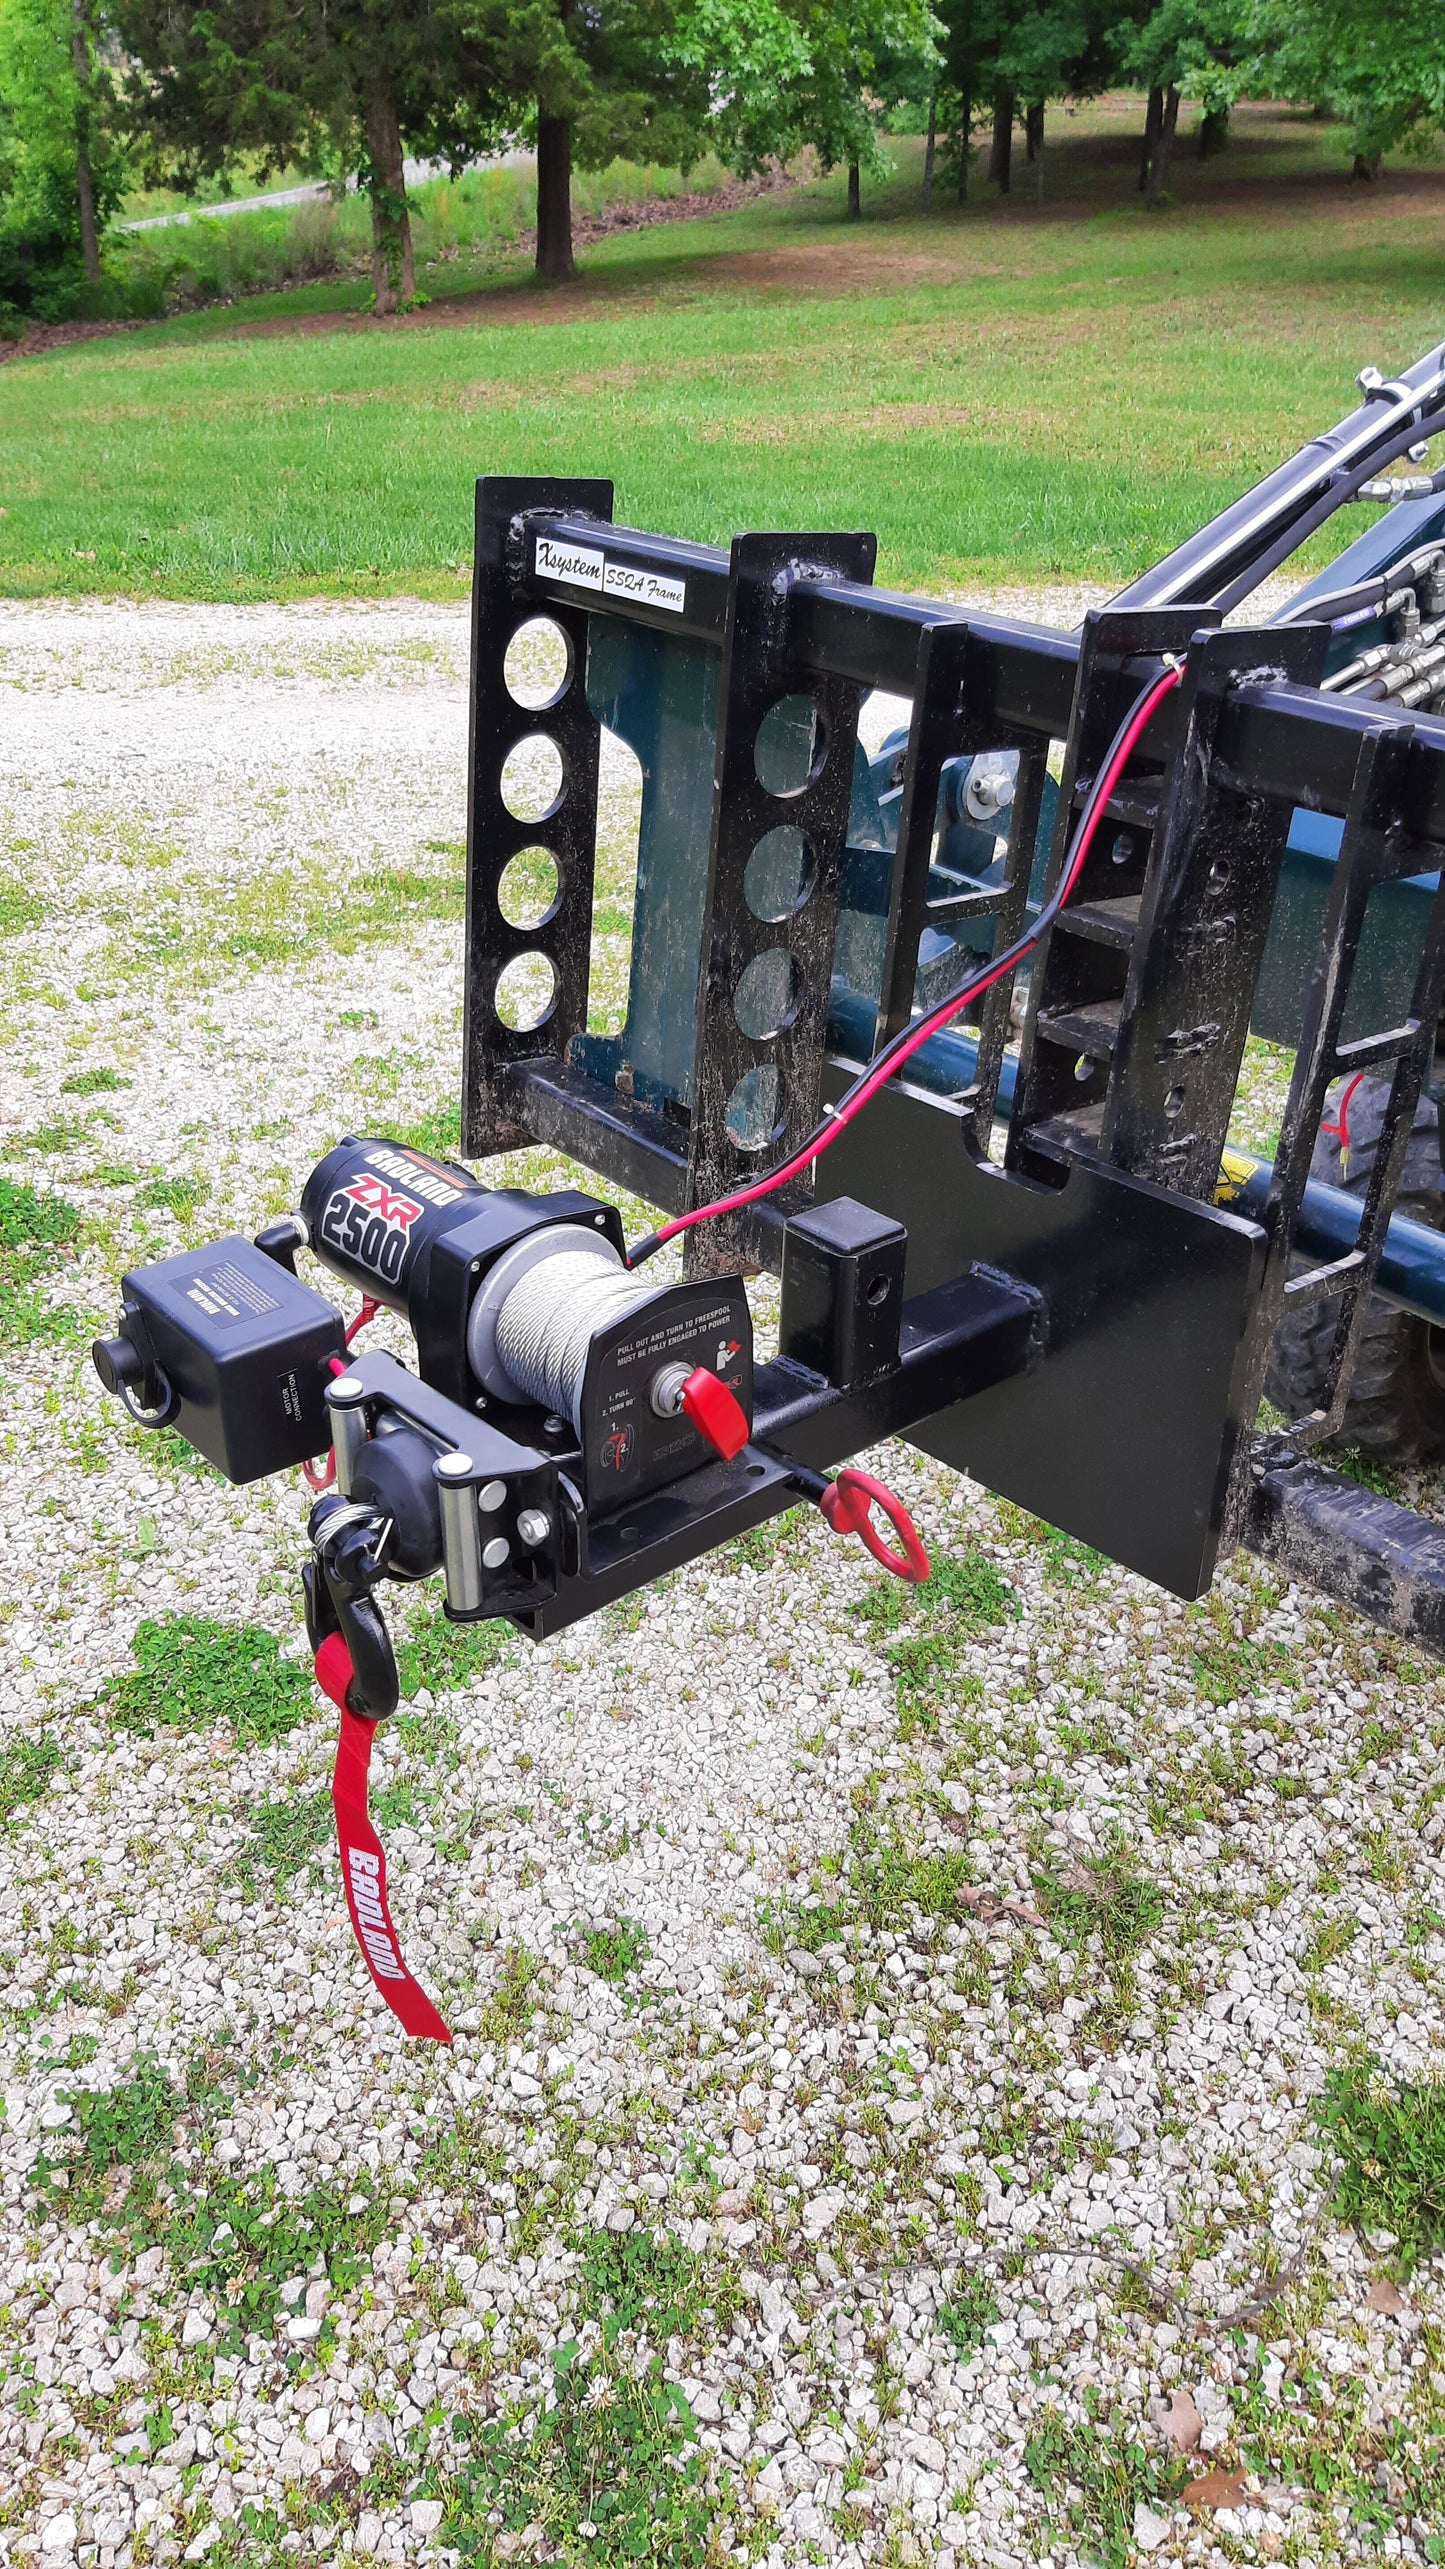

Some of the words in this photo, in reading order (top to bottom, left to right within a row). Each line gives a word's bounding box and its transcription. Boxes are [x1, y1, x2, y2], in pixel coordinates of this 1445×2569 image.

[538, 542, 601, 580] Xsystem
[606, 569, 644, 592] SSQA
[647, 580, 683, 602] Frame
[345, 1174, 422, 1231] ZXR
[363, 1149, 464, 1208] BADLAND
[323, 1192, 407, 1280] 2500
[617, 1343, 634, 1356] PULL
[635, 1336, 649, 1348] OUT
[650, 1331, 665, 1343] AND
[666, 1323, 684, 1339] TURN
[685, 1319, 694, 1329] TO
[694, 1305, 731, 1325] FREESPOOL
[617, 1354, 636, 1367] MUST
[637, 1349, 647, 1358] BE
[648, 1340, 667, 1355] FULLY
[668, 1328, 697, 1346] ENGAGED
[698, 1323, 707, 1333] TO
[708, 1315, 731, 1331] POWER
[282, 1387, 292, 1415] MOTOR
[288, 1373, 302, 1422] CONNECTION
[609, 1402, 625, 1414] TURN
[615, 1388, 630, 1400] PULL
[348, 1846, 407, 1981] BADLAND
